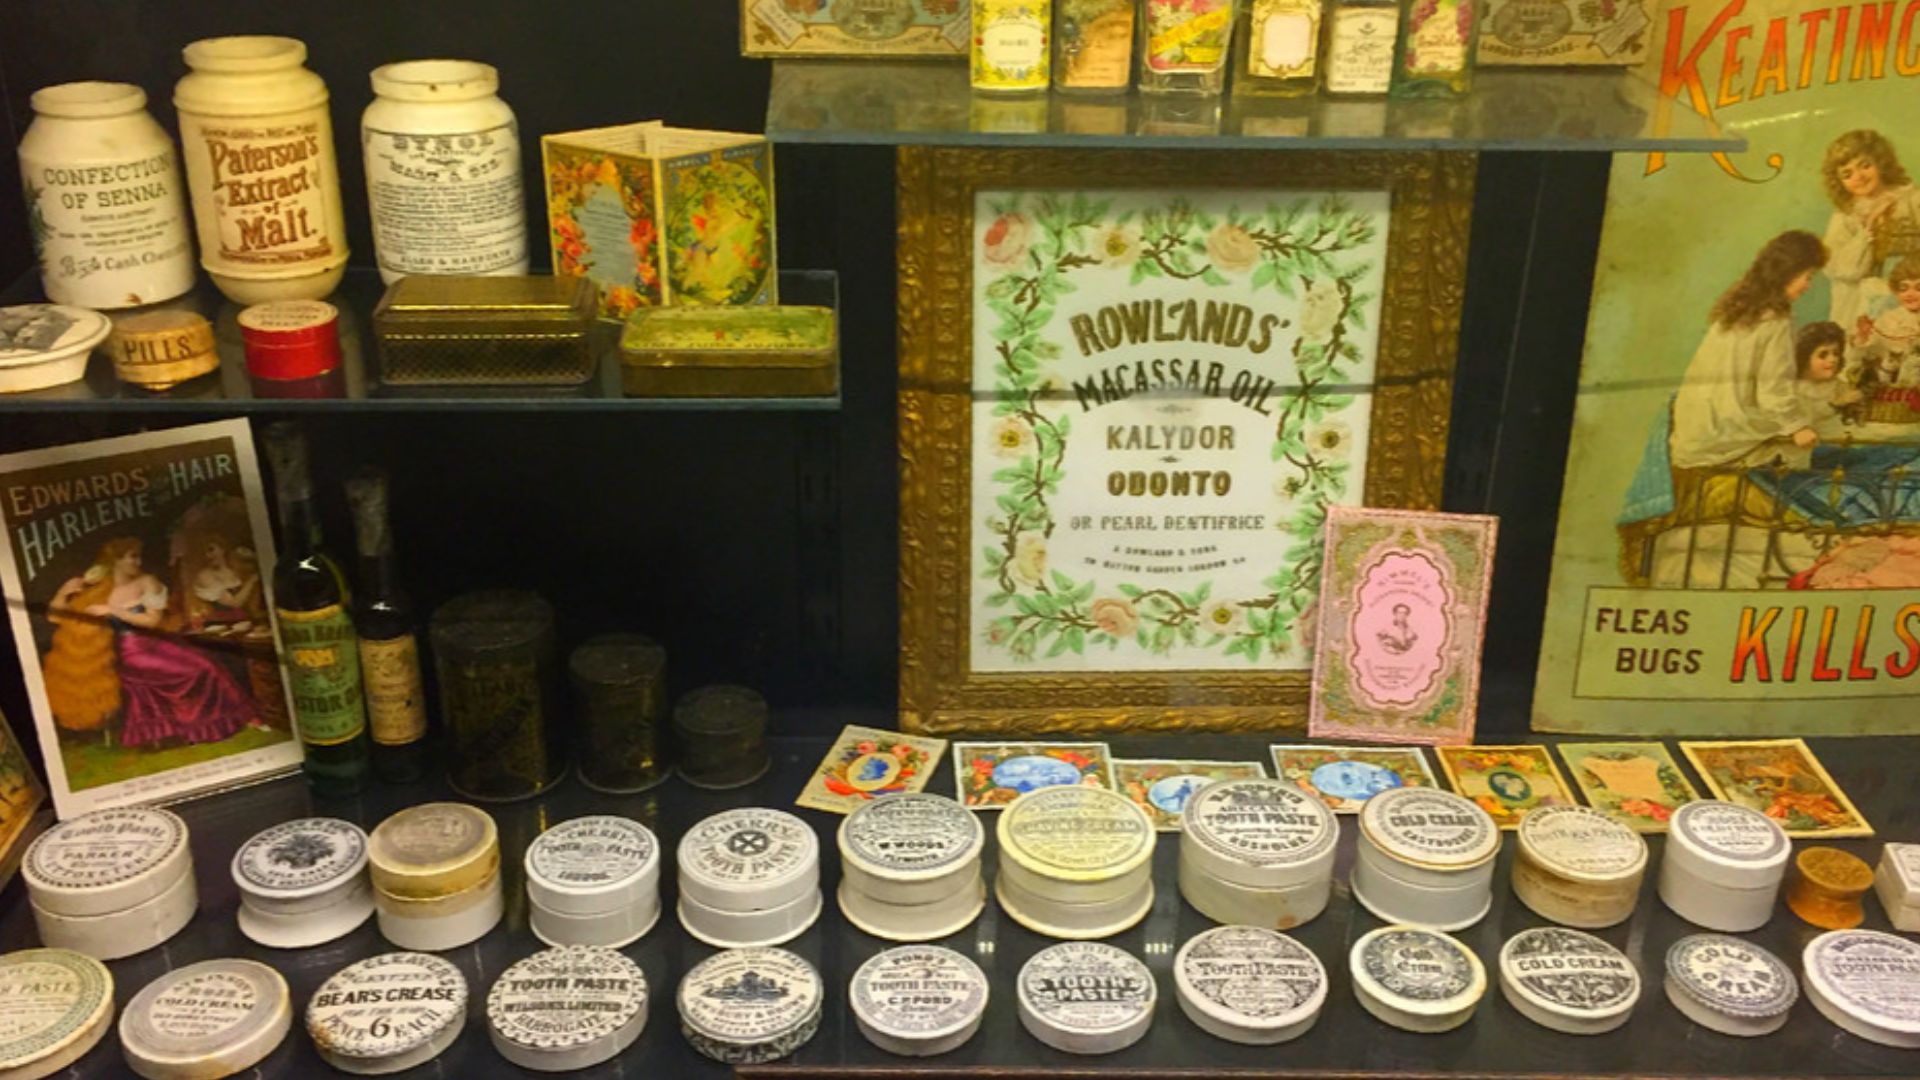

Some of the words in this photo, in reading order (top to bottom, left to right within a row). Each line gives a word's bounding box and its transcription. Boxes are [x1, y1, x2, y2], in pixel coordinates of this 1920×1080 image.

[43, 151, 170, 186] CONFECTION
[205, 136, 319, 191] Paterson's
[61, 192, 88, 209] OF
[97, 182, 167, 208] SENNA
[225, 166, 310, 207] Extract
[263, 202, 280, 215] of
[234, 207, 318, 253] Malt.
[1068, 299, 1291, 356] ROWLANDS'
[124, 335, 192, 363] PILLS
[1072, 359, 1225, 412] MACASSAR
[1229, 366, 1277, 417] OIL
[1107, 425, 1235, 451] KALYDOR
[168, 453, 233, 496] HAIR
[1107, 471, 1232, 496] ODONTO
[1070, 516, 1092, 531] OR
[1101, 516, 1157, 531] PEARL
[1164, 515, 1265, 531] DENTIFRICE
[18, 493, 152, 581] HARLENE
[1595, 608, 1691, 635] FLEAS
[1730, 603, 1920, 684] KILLS
[1615, 648, 1704, 674] BUGS
[701, 819, 792, 839] CHERRY
[1203, 813, 1261, 826] TOOTH
[1265, 813, 1320, 826] PASTE
[1389, 814, 1427, 827] COLD
[700, 845, 744, 874] TOOTH
[751, 843, 797, 874] PASTE
[1518, 959, 1564, 971] COLD
[1568, 958, 1625, 971] CREAM
[1695, 947, 1753, 963] COLD
[1196, 962, 1251, 976] TOOTH
[1253, 962, 1308, 977] PASTE
[20, 982, 73, 993] PASTE
[511, 978, 569, 992] TOOTH
[573, 978, 630, 992] PASTE
[870, 981, 919, 991] TOOTH
[923, 981, 967, 991] PASTE
[1050, 976, 1125, 988] TOOTH
[1702, 970, 1771, 994] CREAM
[199, 1000, 255, 1010] CREAM
[385, 987, 457, 1002] GREASE
[1057, 988, 1121, 1001] PASTE
